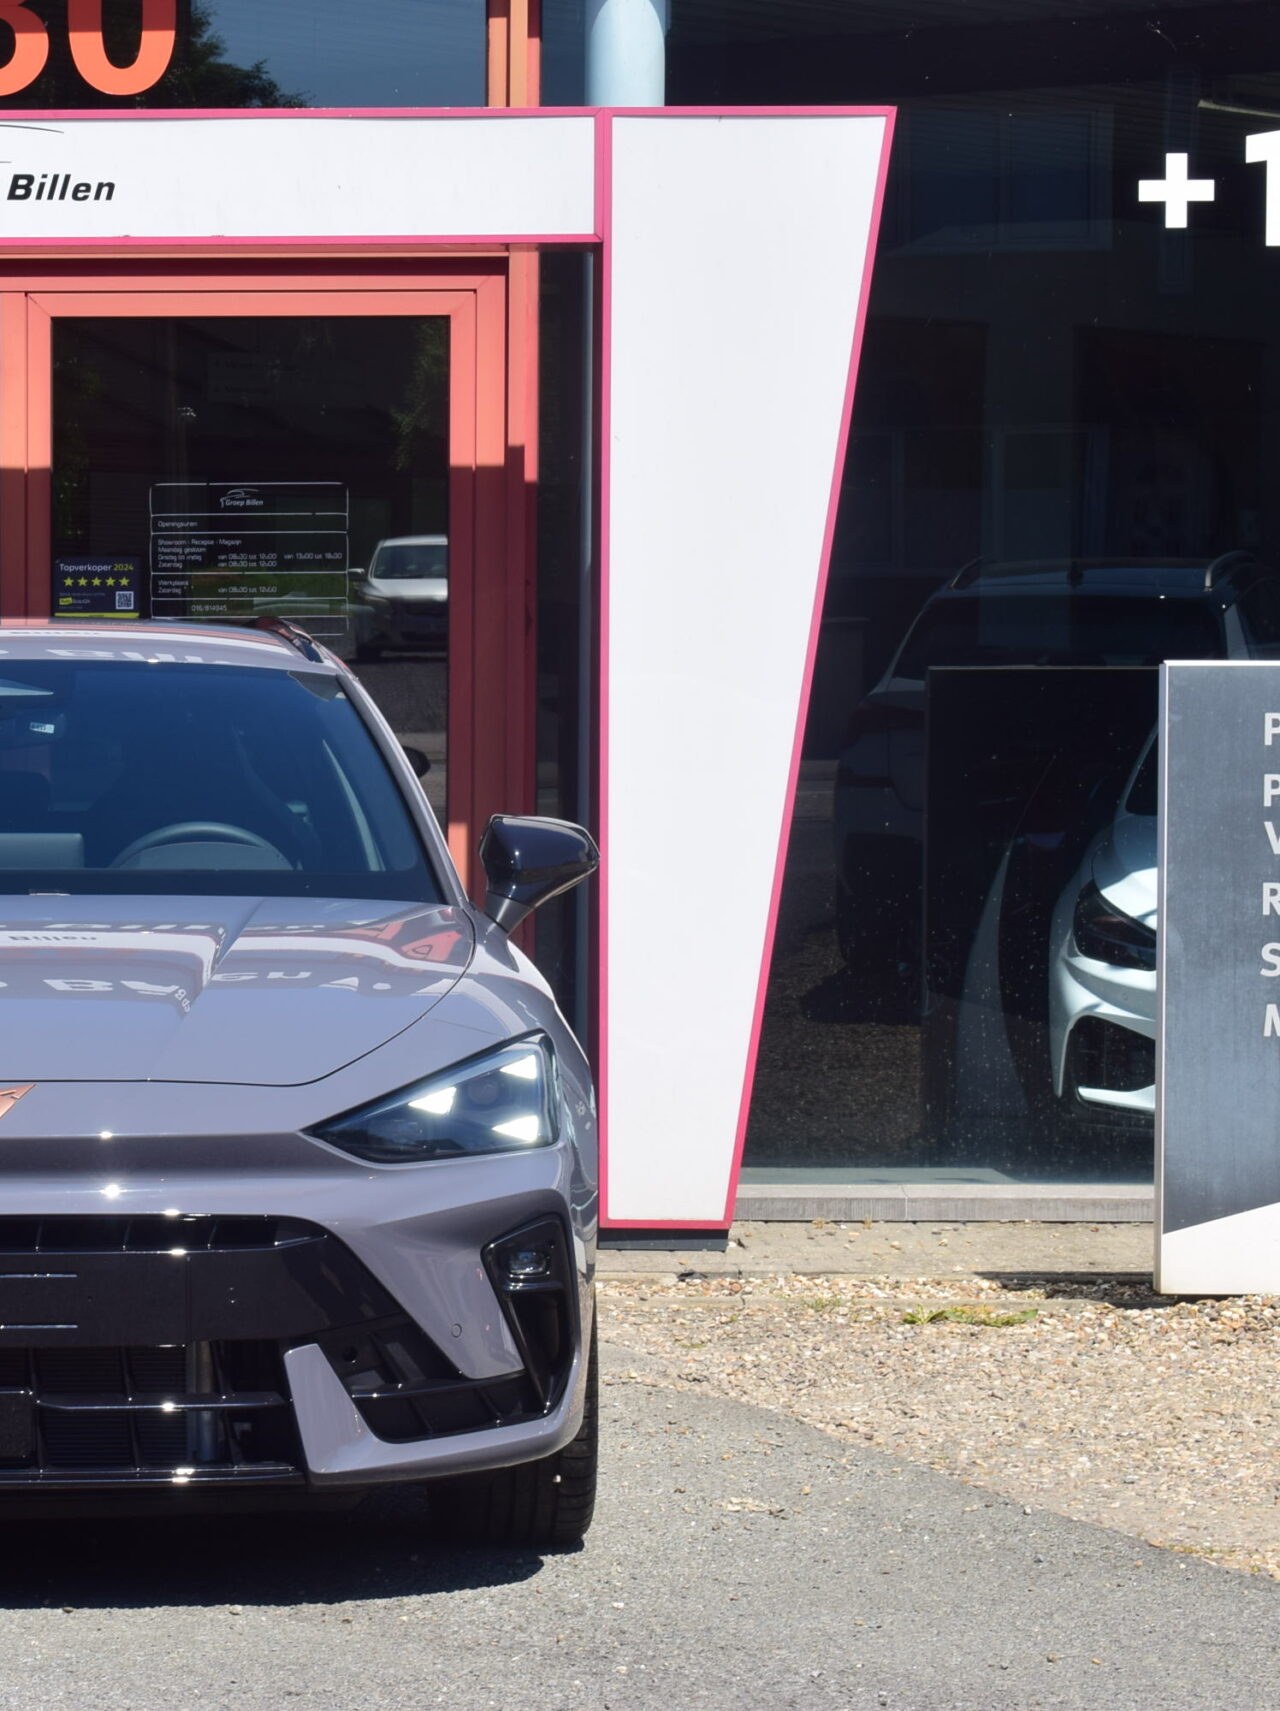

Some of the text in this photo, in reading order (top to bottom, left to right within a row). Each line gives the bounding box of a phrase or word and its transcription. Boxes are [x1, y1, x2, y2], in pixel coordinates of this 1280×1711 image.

[6, 173, 116, 202] Billen
[225, 499, 245, 507] Groep
[60, 563, 135, 573] Topverkoper 2024
